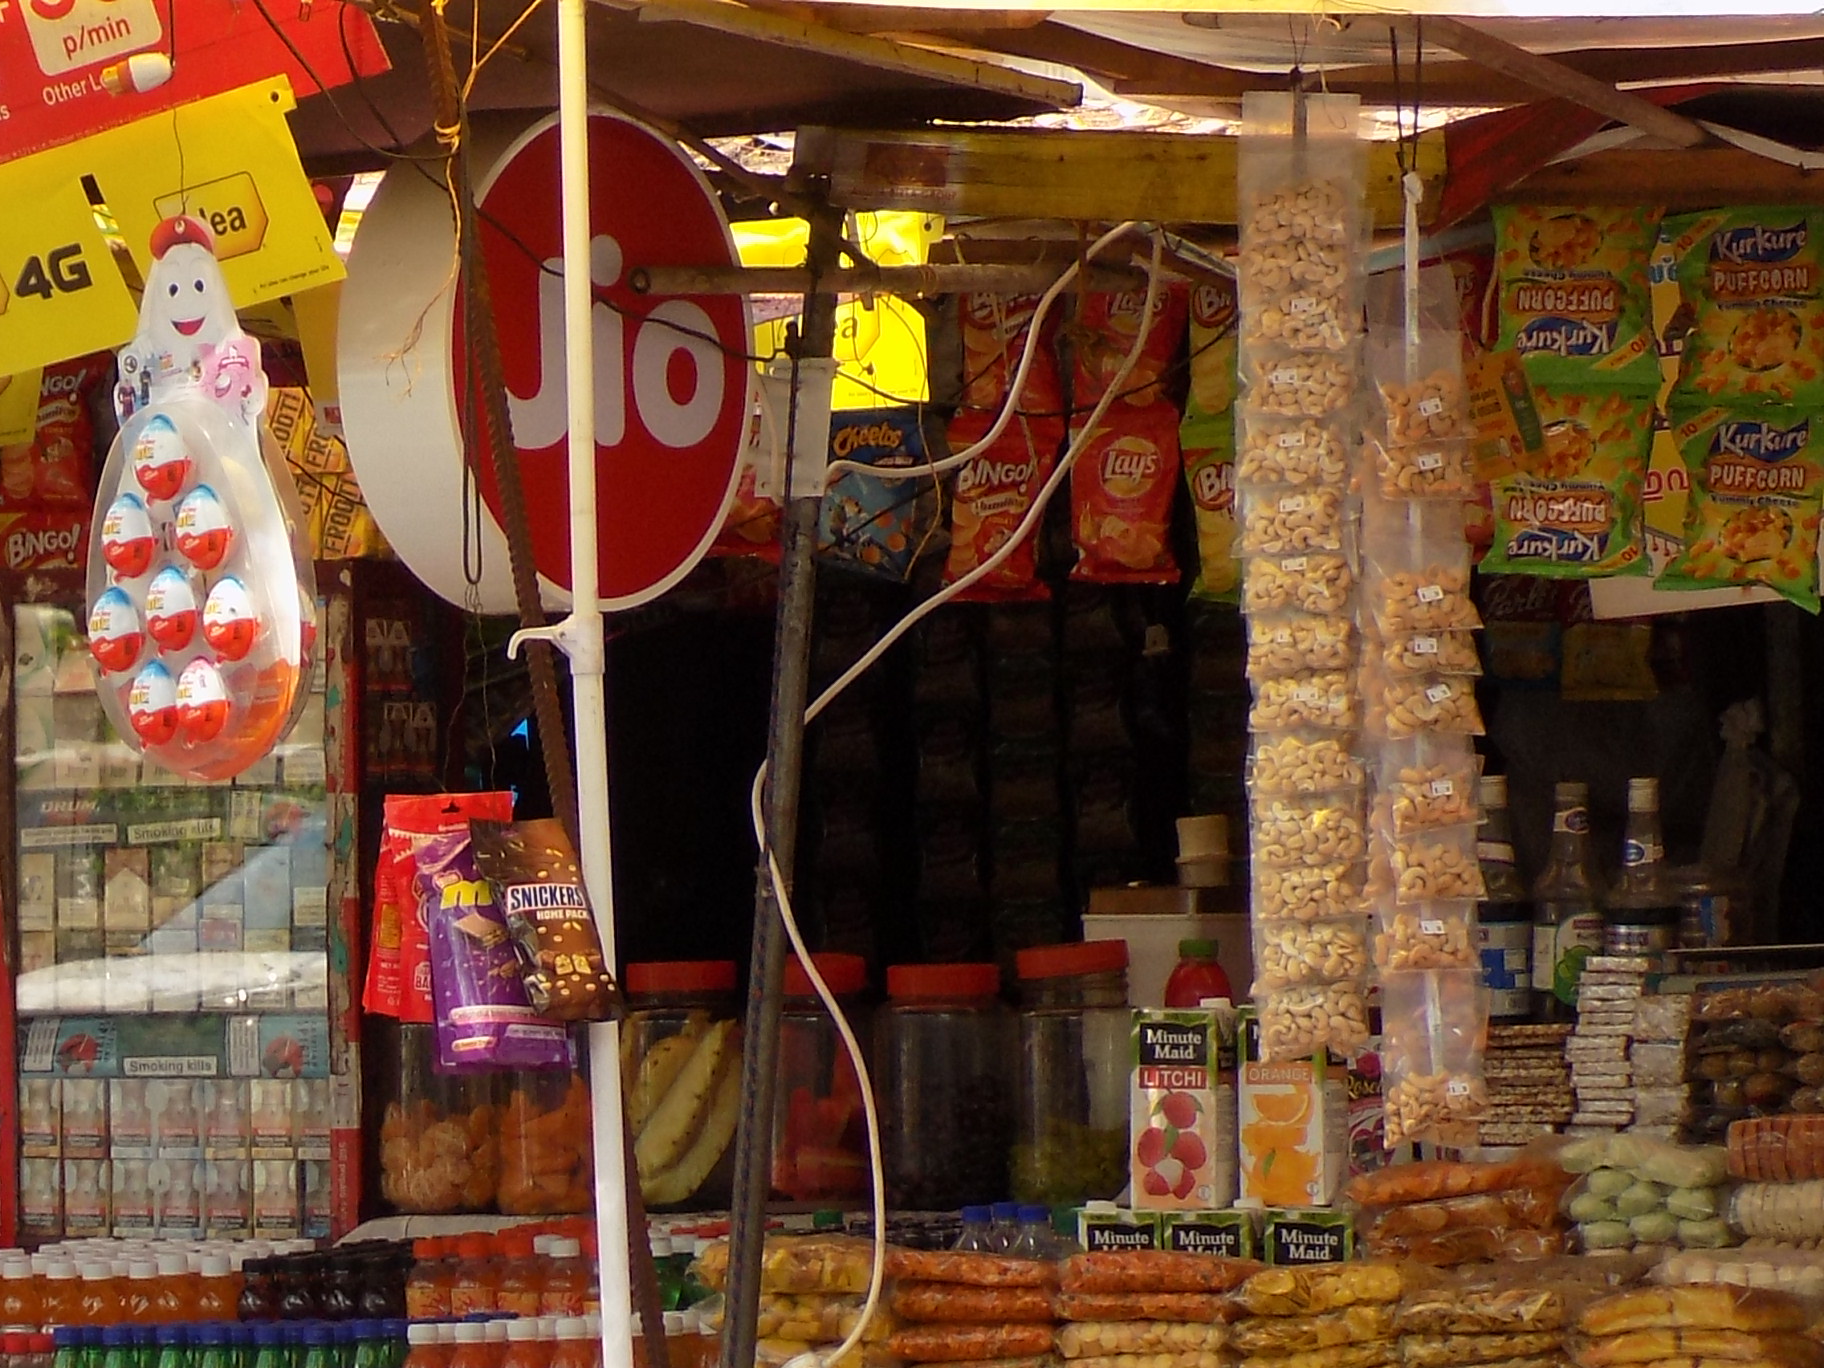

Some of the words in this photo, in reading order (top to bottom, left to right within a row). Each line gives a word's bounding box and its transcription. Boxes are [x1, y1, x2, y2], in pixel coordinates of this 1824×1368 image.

[62, 16, 131, 61] p/min
[42, 79, 85, 106] Other
[1712, 222, 1808, 262] Kurkure
[15, 242, 93, 302] 4G
[1712, 264, 1810, 293] PUFFCORN
[1516, 287, 1615, 312] PUFFCORN
[508, 234, 724, 450] Jio
[1516, 318, 1611, 356] Kurkure
[833, 424, 904, 457] Cheetos
[1717, 423, 1808, 457] Kurkure
[1710, 463, 1806, 489] PUFFCORN
[7, 523, 82, 568] BINGO!
[1507, 532, 1600, 562] Kurkure
[510, 884, 584, 910] SNICKERS
[536, 909, 565, 921] HOME
[1145, 1029, 1202, 1045] Minute
[1154, 1044, 1194, 1060] Maid
[128, 1059, 185, 1075] Smoking
[186, 1057, 213, 1073] kills
[1143, 1069, 1203, 1087] LITCHI
[1248, 1068, 1309, 1082] ORANGE
[1093, 1229, 1149, 1246] Minute
[1178, 1229, 1235, 1247] Minute
[1280, 1227, 1339, 1247] Minute
[1288, 1243, 1331, 1261] Maid
